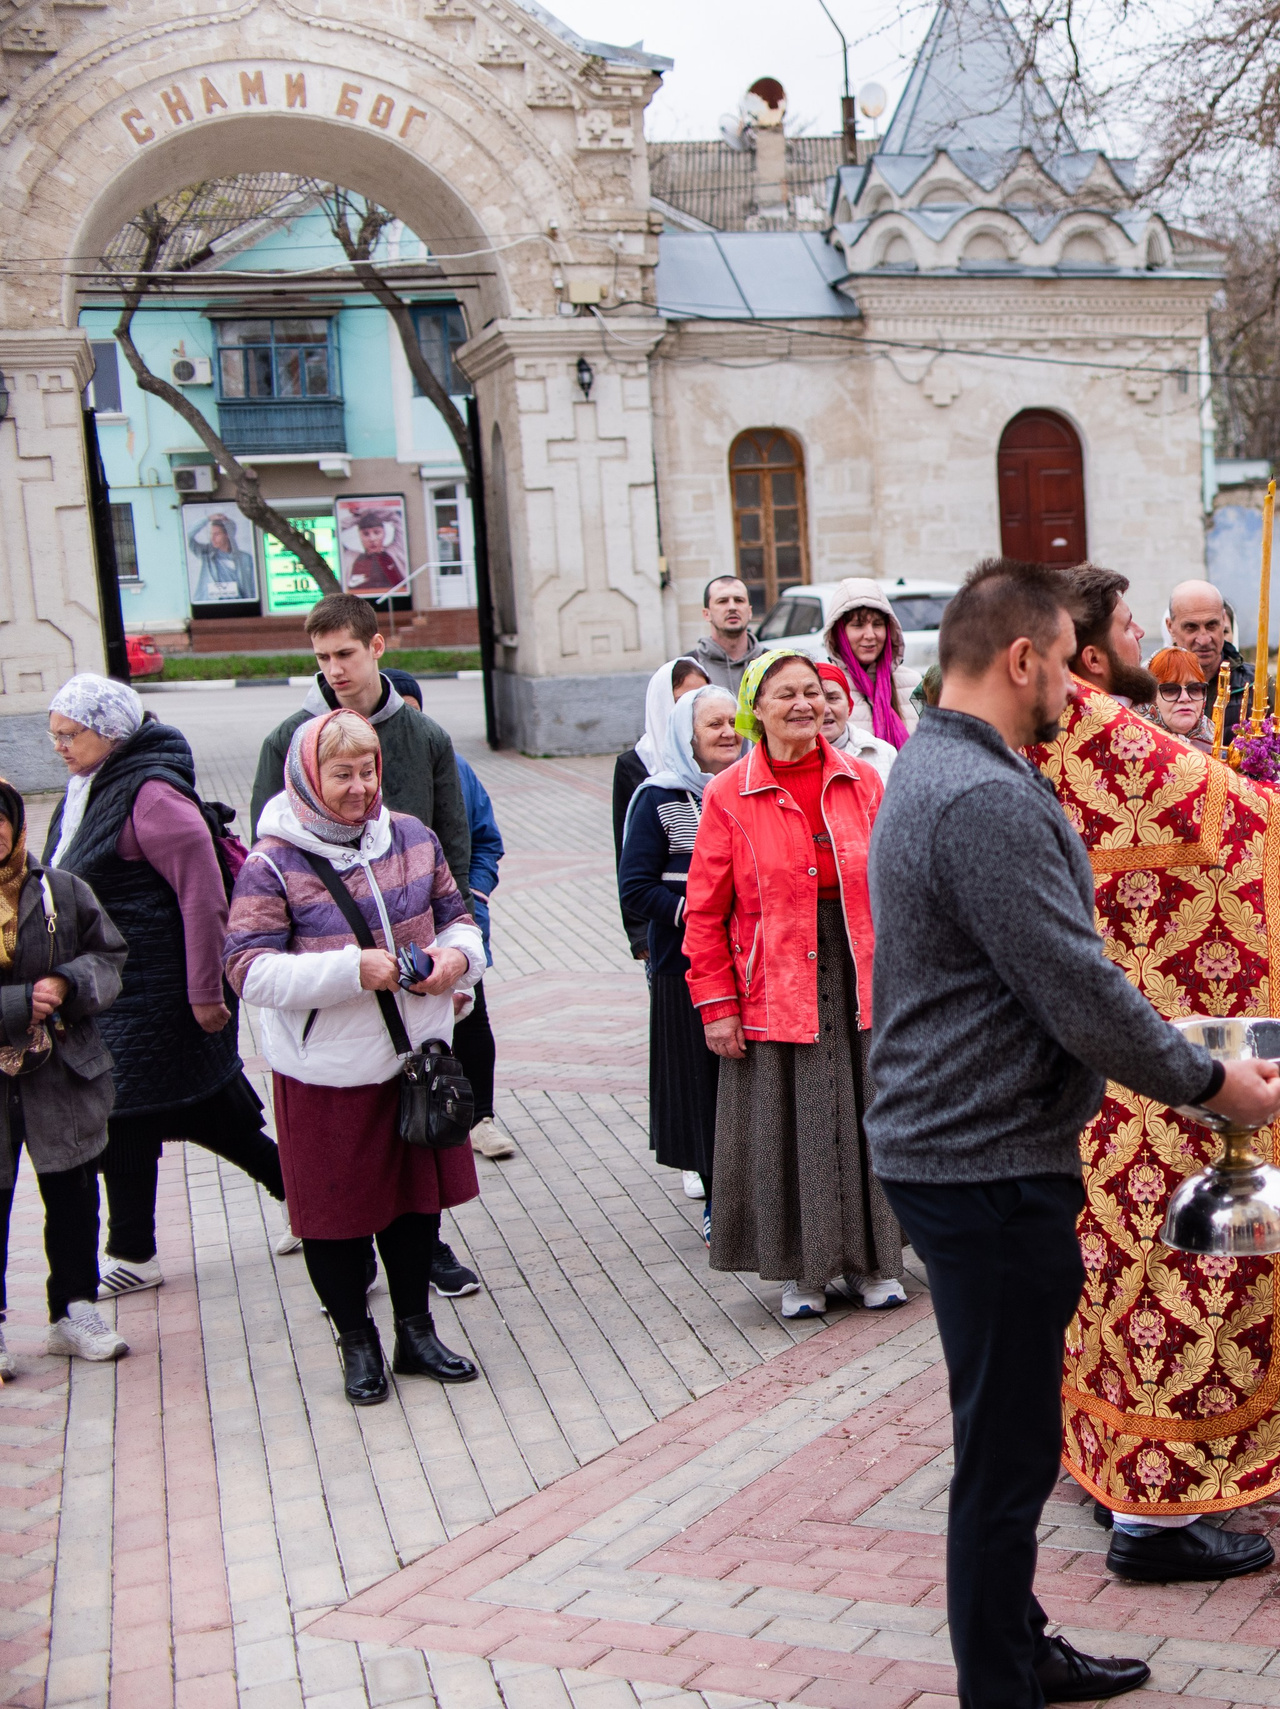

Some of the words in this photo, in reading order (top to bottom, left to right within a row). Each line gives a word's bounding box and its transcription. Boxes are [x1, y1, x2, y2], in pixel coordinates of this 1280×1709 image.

[121, 107, 155, 144] С
[160, 70, 306, 124] НАМИ
[336, 82, 427, 138] БОГ
